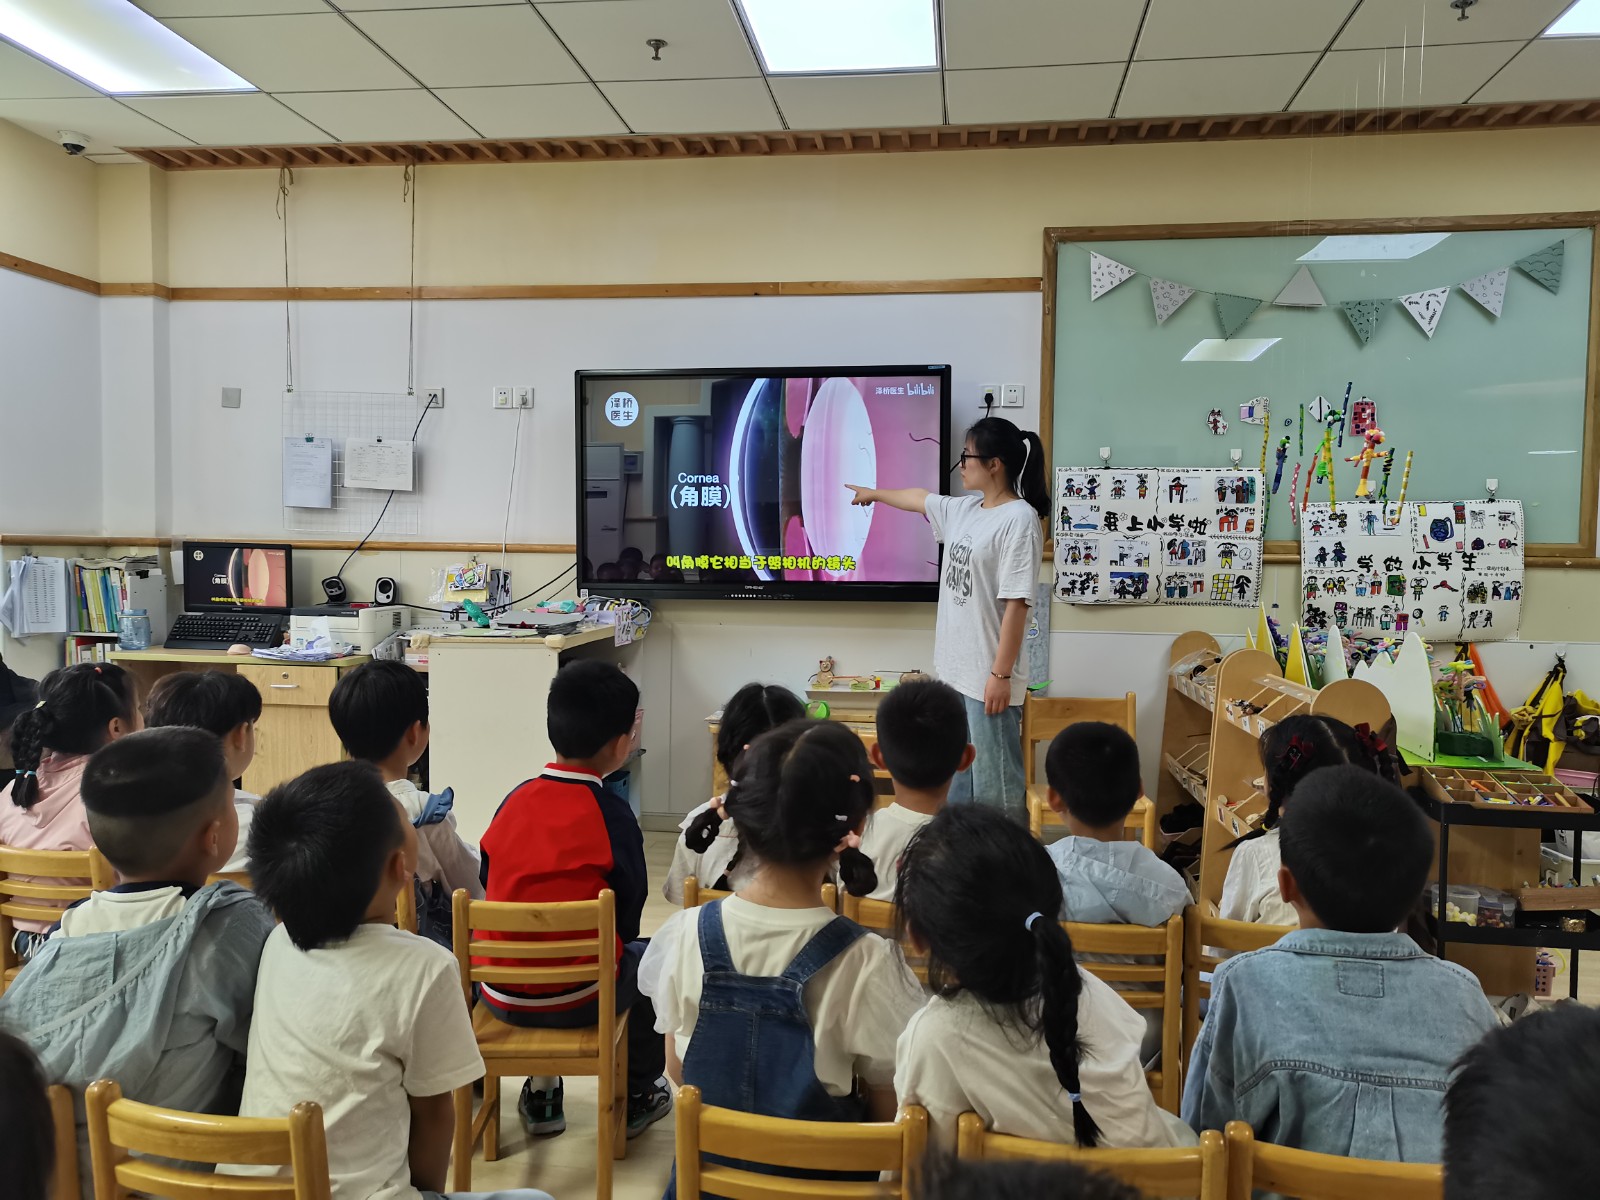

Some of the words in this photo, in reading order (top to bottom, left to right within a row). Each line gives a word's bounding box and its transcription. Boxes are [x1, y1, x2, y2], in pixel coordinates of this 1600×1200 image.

[906, 382, 935, 396] bilibili
[610, 410, 634, 421] 医生
[677, 472, 720, 484] Cornea
[665, 555, 856, 570] 叫角膜它相当于照相机的镜头
[1356, 552, 1477, 573] 学做小学生
